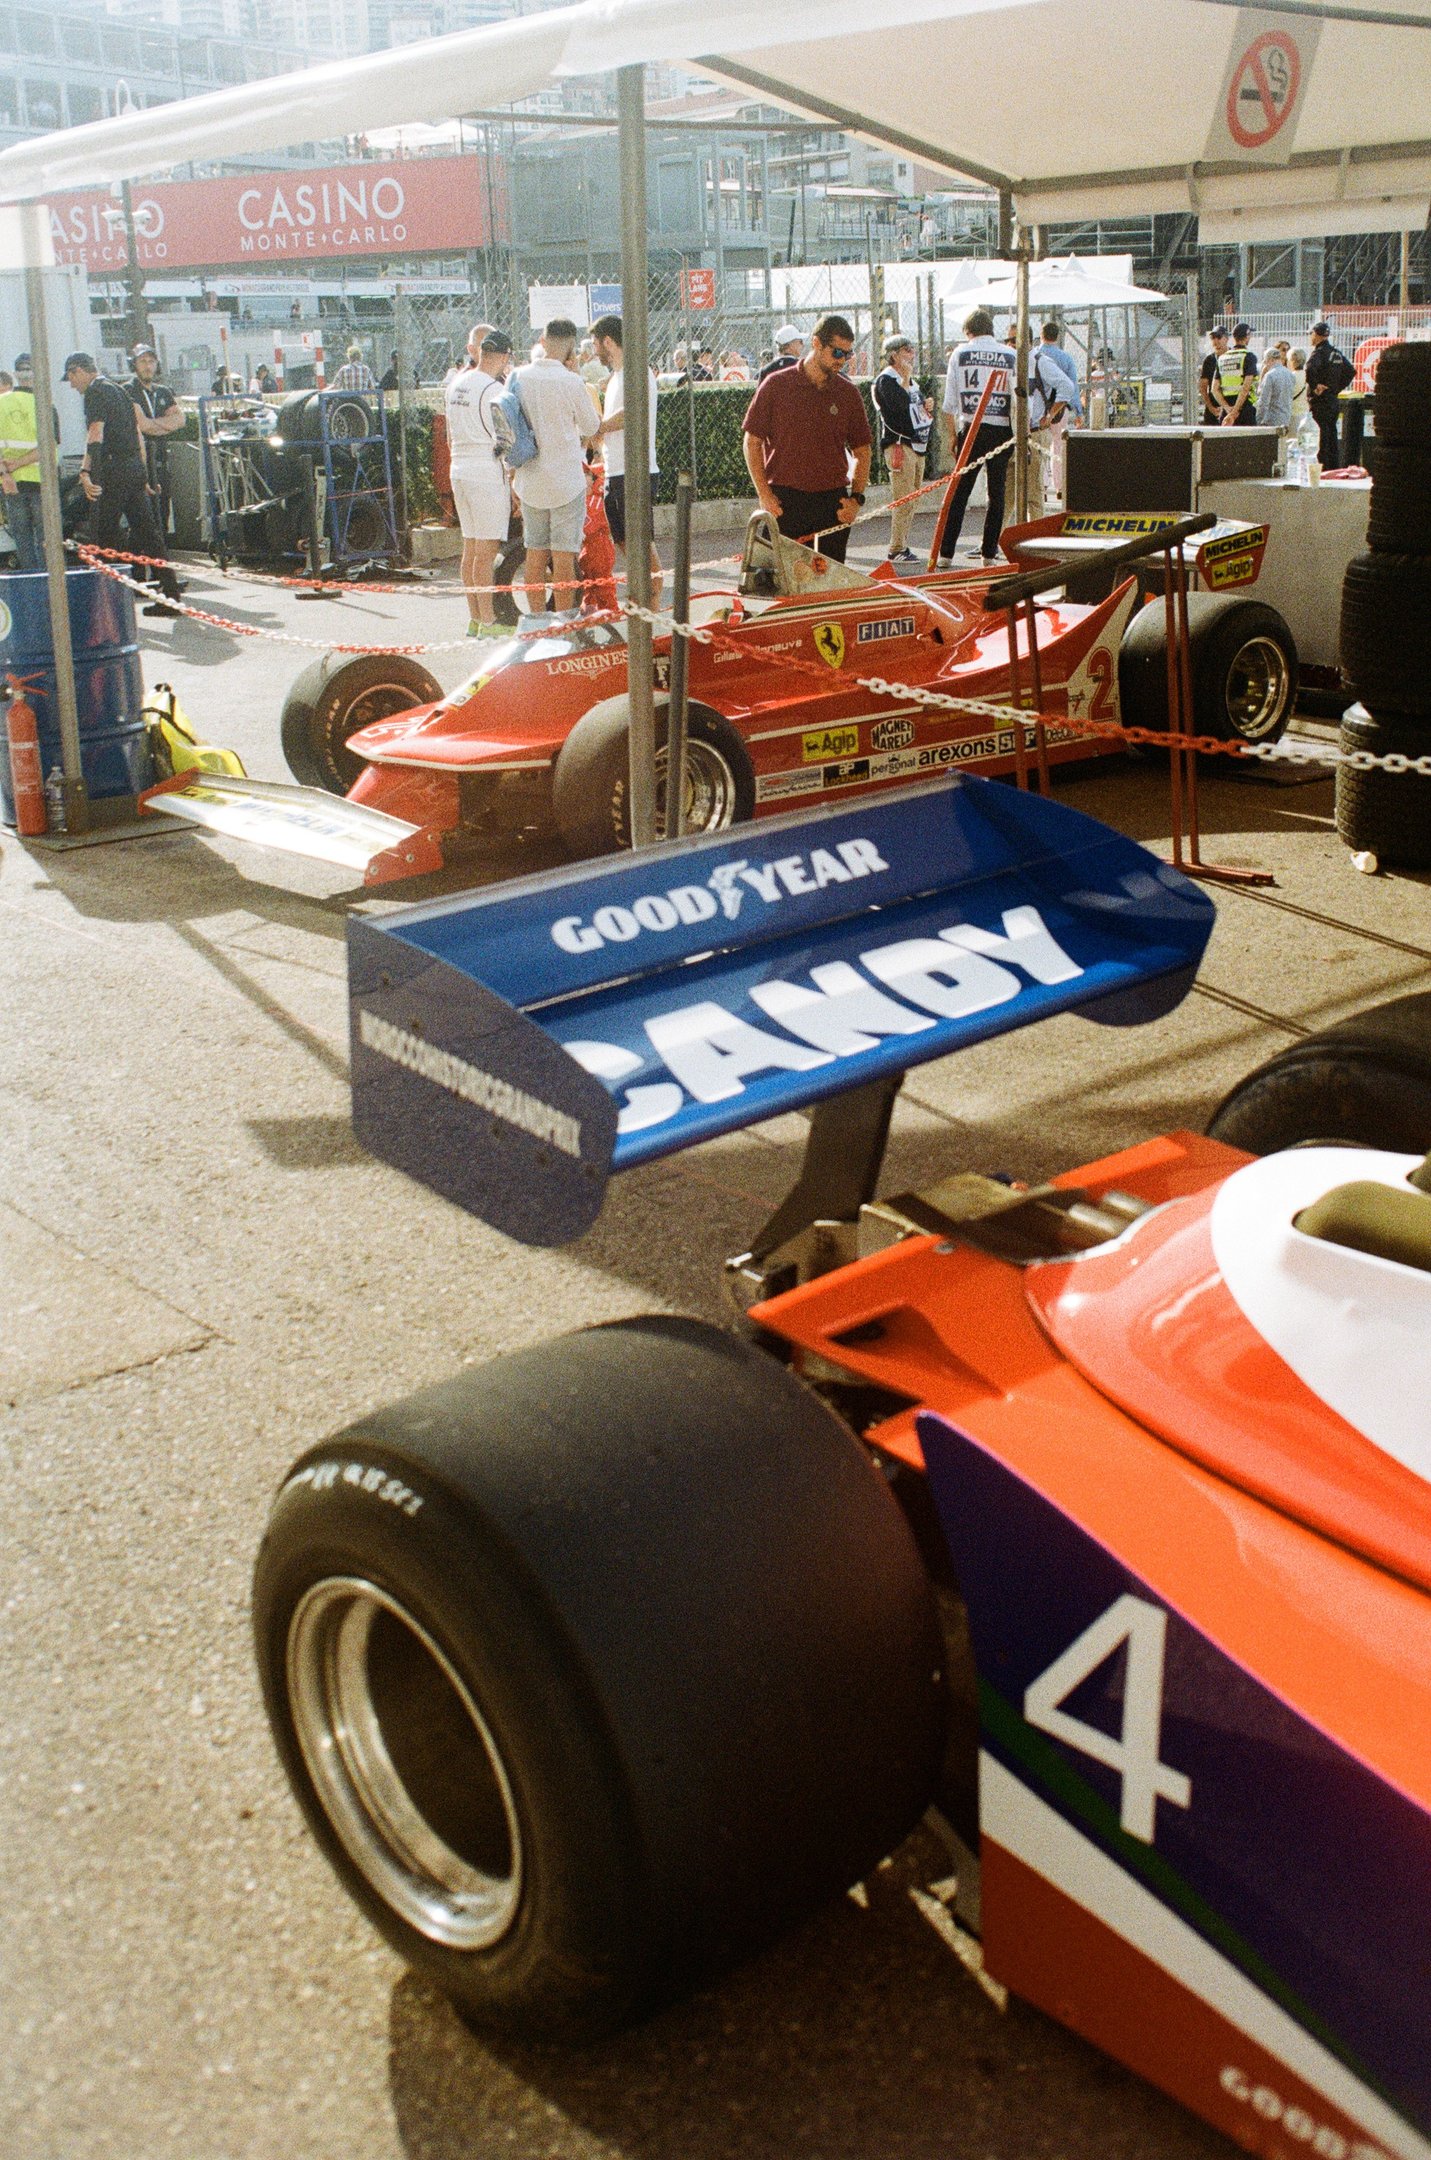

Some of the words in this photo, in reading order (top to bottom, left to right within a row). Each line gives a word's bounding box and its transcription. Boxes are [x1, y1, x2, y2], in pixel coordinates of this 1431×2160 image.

[238, 177, 405, 230] CASINO
[50, 200, 165, 244] ASIO
[240, 231, 316, 251] MONTE
[332, 224, 407, 245] CARLO
[54, 249, 88, 264] NTE
[970, 351, 1006, 363] MEDIA
[964, 368, 979, 389] 14
[964, 394, 1007, 408] MOACO
[1065, 518, 1175, 533] MICHELIN
[1205, 531, 1263, 558] MICHELIN
[1226, 560, 1251, 579] Agip
[861, 619, 912, 641] FIAT
[546, 651, 629, 675] LONGINES
[1087, 646, 1116, 721] 2
[822, 732, 857, 755] Agip
[919, 737, 996, 766] arexons
[871, 757, 916, 777] personal
[551, 838, 890, 955] GOODYEAR
[562, 905, 1084, 1132] CANDY
[1024, 1593, 1191, 1844] 4
